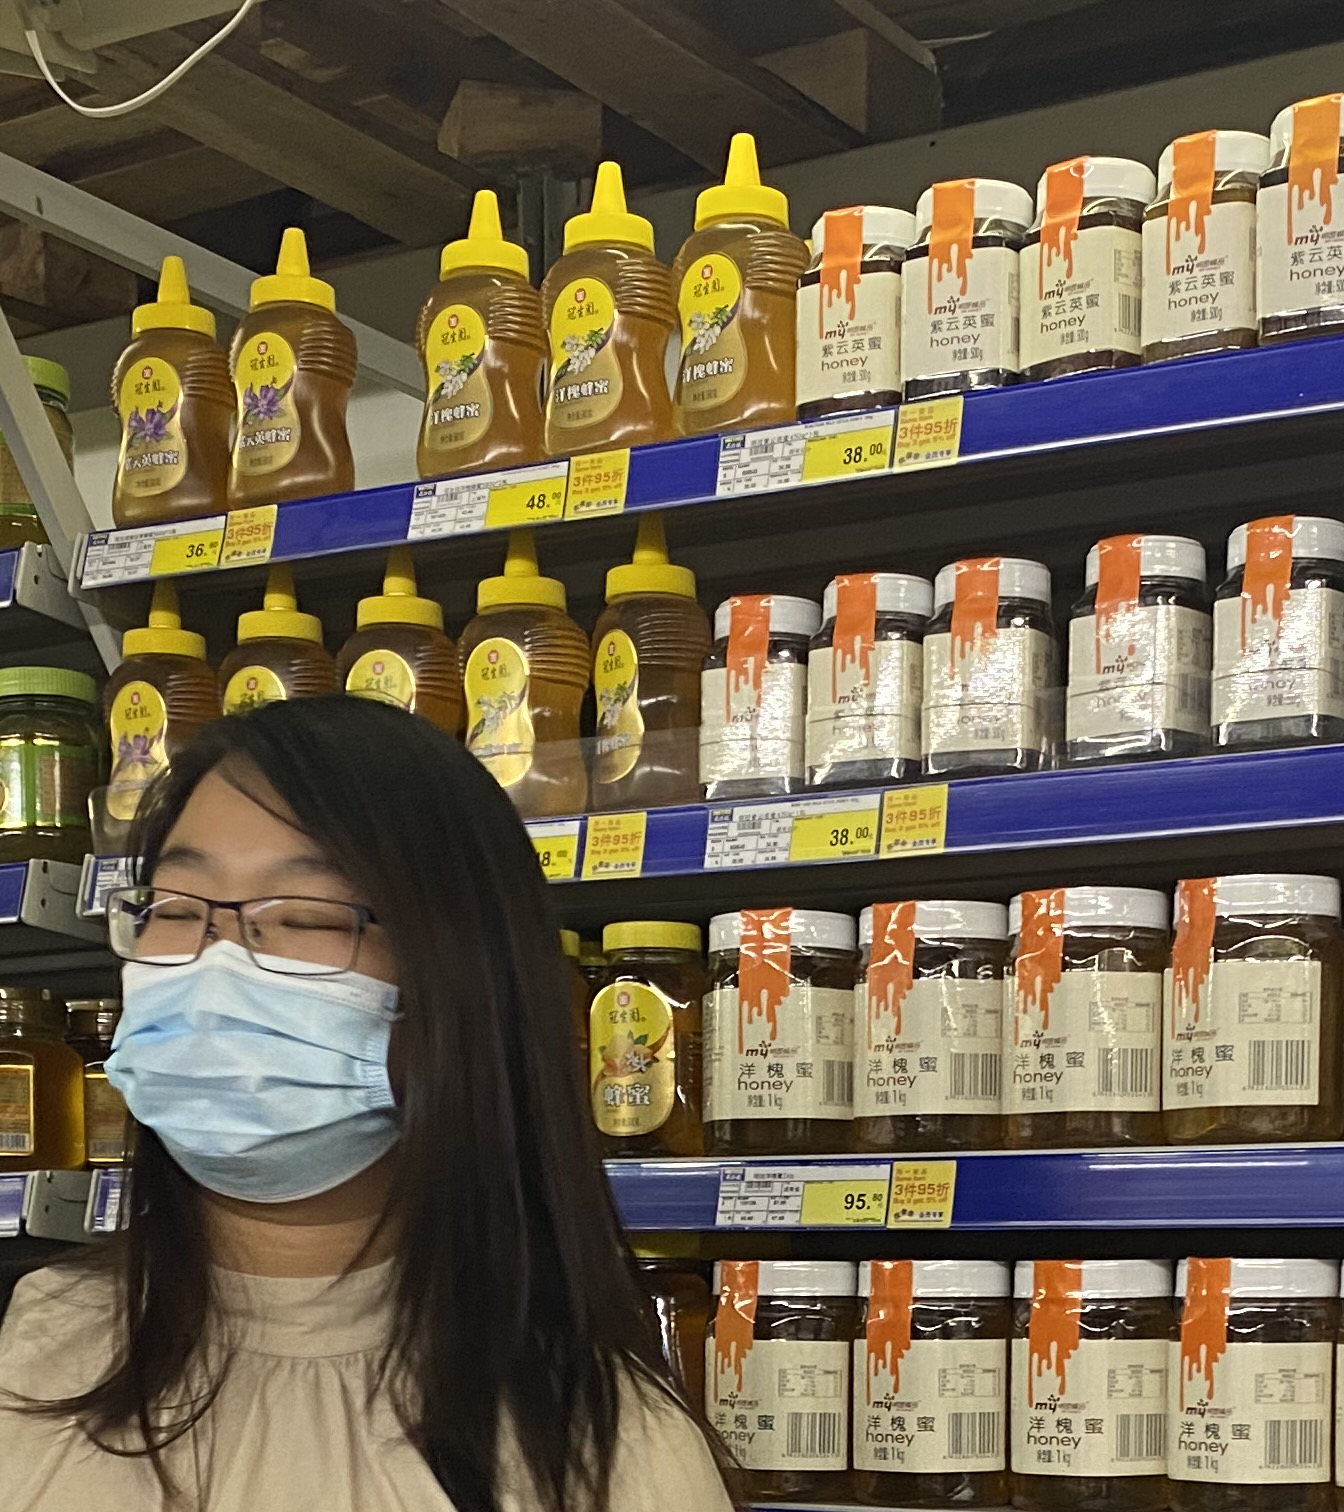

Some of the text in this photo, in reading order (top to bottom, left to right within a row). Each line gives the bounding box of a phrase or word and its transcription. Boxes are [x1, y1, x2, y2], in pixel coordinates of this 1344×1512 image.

[1169, 271, 1235, 295] 紫云英蜜
[1041, 294, 1100, 320] 紫云英蜜
[1167, 292, 1219, 310] honey
[930, 313, 995, 335] 紫云英蜜
[1040, 314, 1086, 334] honey
[822, 337, 882, 359] 紫云英蜜
[930, 332, 980, 349] honey
[820, 354, 868, 372] honey
[898, 418, 957, 440] 3件95折
[842, 442, 884, 468] 38.00
[573, 471, 622, 486] 3件95折
[227, 523, 273, 541] 3件95折
[884, 805, 942, 826] 3件95折
[590, 830, 642, 850] 3件95折
[830, 827, 869, 847] 38.00
[1013, 1052, 1085, 1072] 洋槐蜜
[1171, 1044, 1235, 1064] 洋槐蜜
[739, 1061, 813, 1079] 洋槐蜜
[867, 1055, 938, 1075] 洋槐蜜
[1170, 1062, 1213, 1080] honey
[737, 1076, 794, 1093] honey
[867, 1072, 917, 1090] honey
[1013, 1069, 1063, 1086] honey
[603, 1081, 651, 1108] 蜂蜜
[893, 1182, 950, 1198] 3件95折
[866, 1415, 936, 1434] 洋槐蜜
[1028, 1416, 1105, 1436] 洋槐蜜
[1179, 1422, 1252, 1442] 洋槐蜜
[865, 1430, 914, 1447] honey
[1027, 1432, 1081, 1449] honey
[1178, 1439, 1228, 1455] honey
